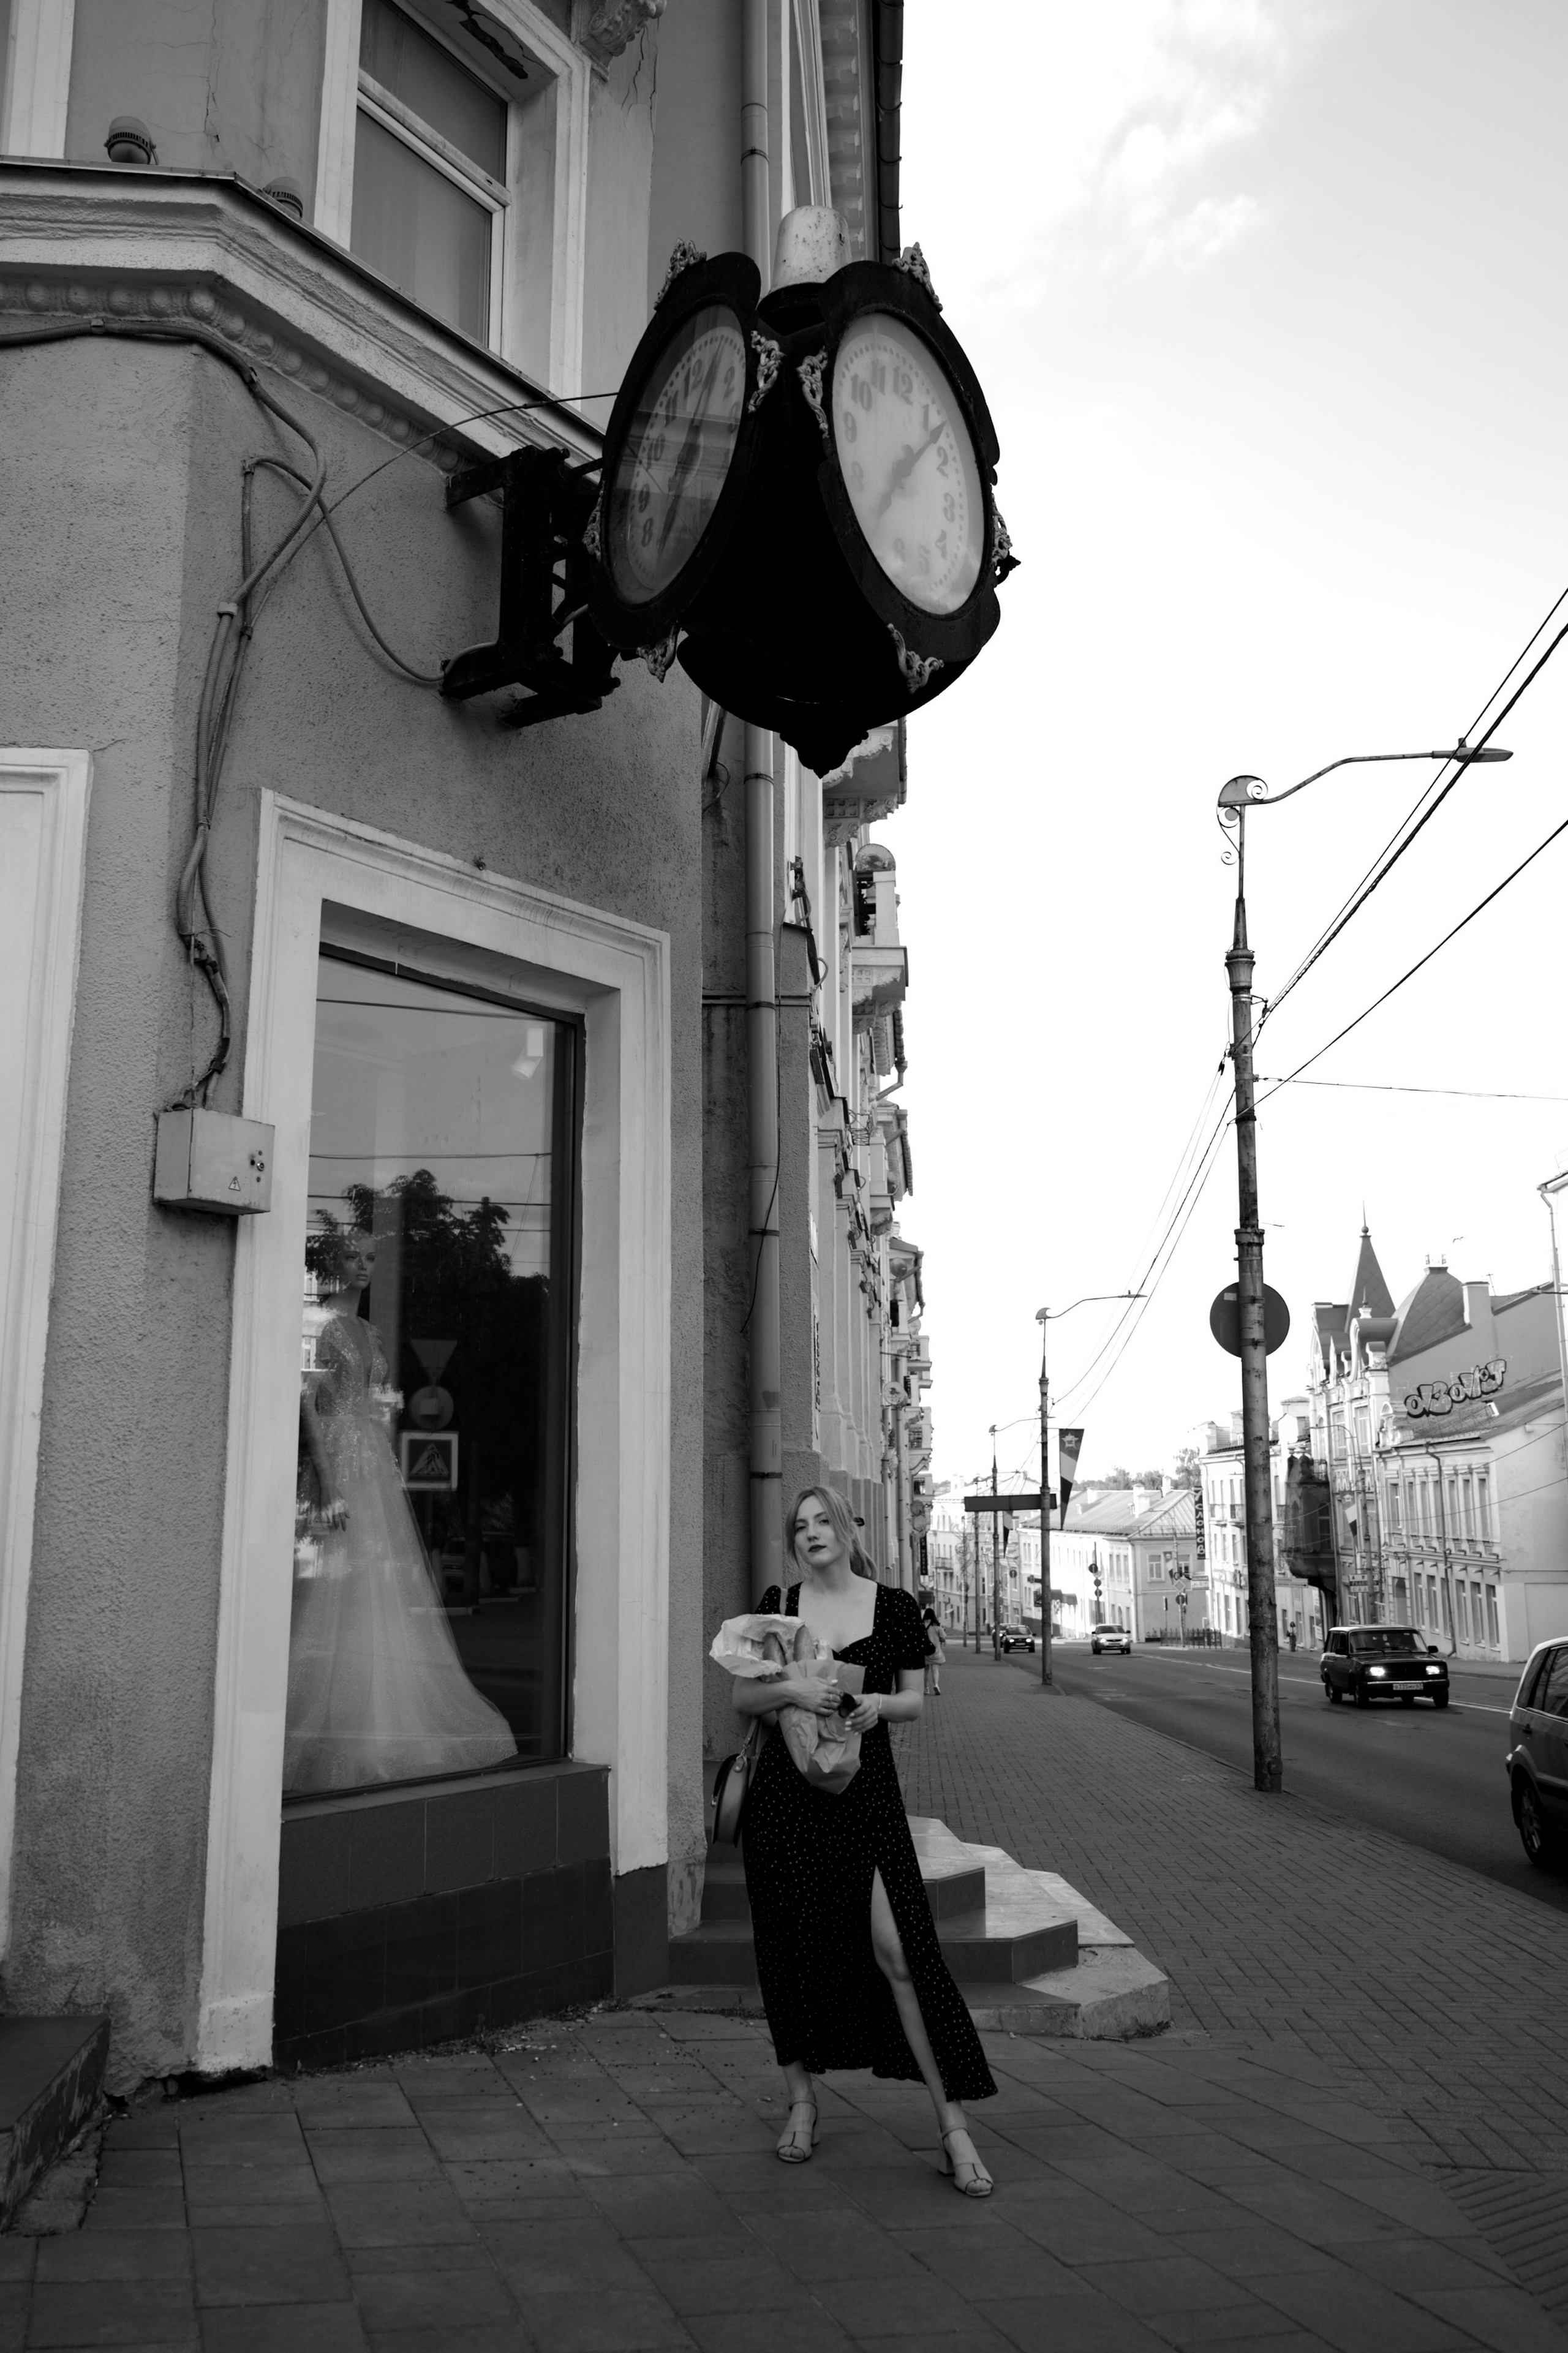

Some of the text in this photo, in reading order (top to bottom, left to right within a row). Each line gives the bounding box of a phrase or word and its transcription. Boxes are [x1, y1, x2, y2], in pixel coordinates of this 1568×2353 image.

[684, 358, 703, 400] 12
[871, 358, 886, 395] 11
[892, 366, 913, 405] 12
[851, 374, 872, 412] 10
[843, 411, 857, 443] 9
[922, 403, 930, 432] 1
[937, 446, 949, 477] 2
[639, 483, 650, 513] 9
[943, 492, 956, 523] 3
[641, 517, 654, 548] 8
[935, 529, 948, 560] 4
